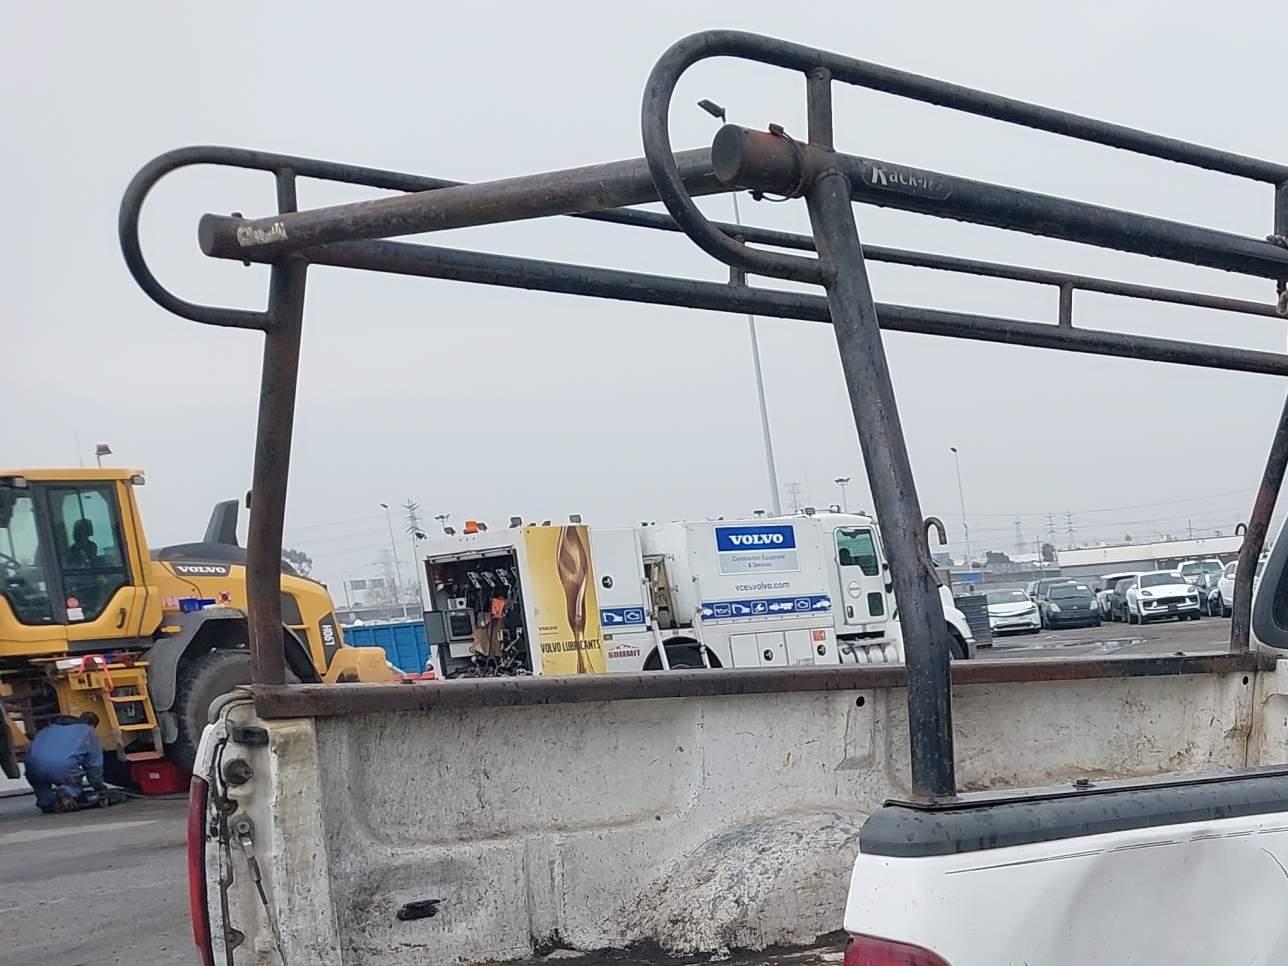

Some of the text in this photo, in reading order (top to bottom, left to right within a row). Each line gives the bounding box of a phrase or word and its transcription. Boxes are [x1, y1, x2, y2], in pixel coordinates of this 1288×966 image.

[729, 533, 784, 545] VOLVO
[736, 581, 790, 591] vcesvolvo.com
[540, 639, 600, 653] VOLVO LUBRICANTS
